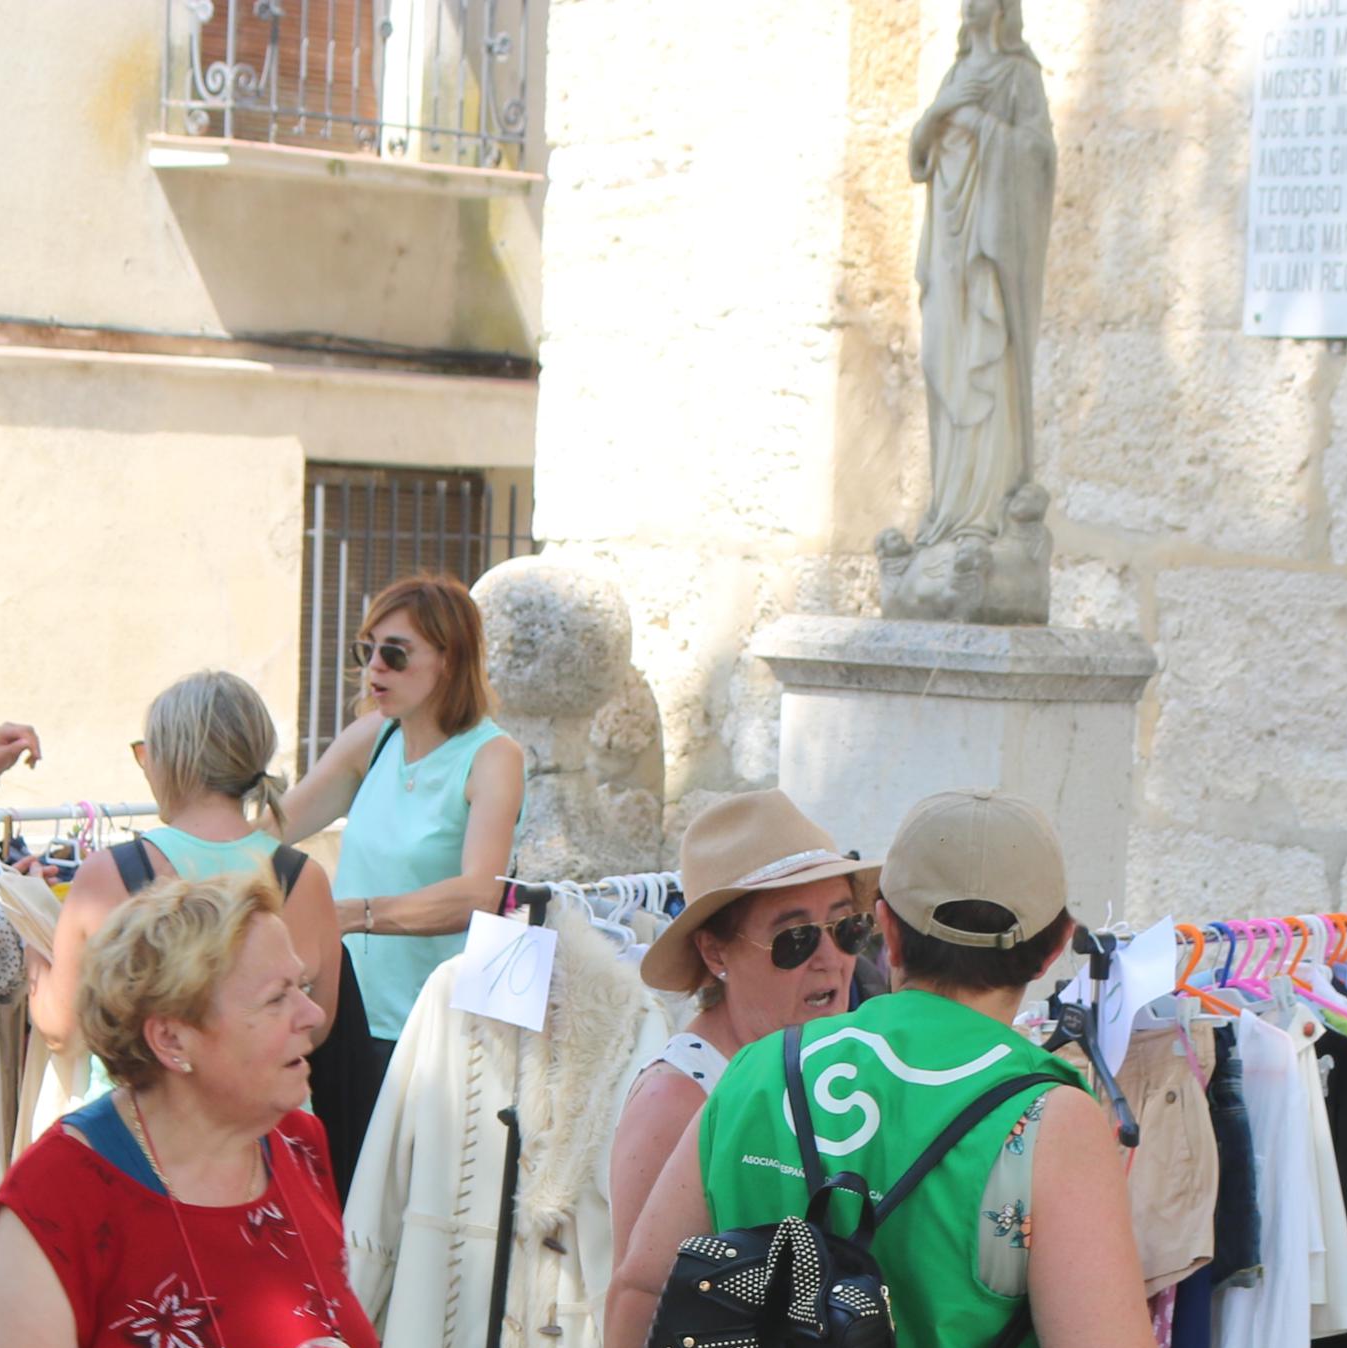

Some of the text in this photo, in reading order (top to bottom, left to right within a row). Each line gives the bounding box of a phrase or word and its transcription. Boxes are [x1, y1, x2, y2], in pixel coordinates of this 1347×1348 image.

[1263, 28, 1325, 61] CESAR
[1261, 67, 1322, 100] MOISES
[1260, 107, 1299, 139] JOSE
[1305, 106, 1325, 137] DE
[1258, 146, 1322, 178] ANDRES
[1257, 185, 1342, 217] TEODOSIO
[1255, 223, 1316, 254] NICOLAS
[1252, 262, 1313, 292] JULIAN
[481, 920, 541, 998] 10
